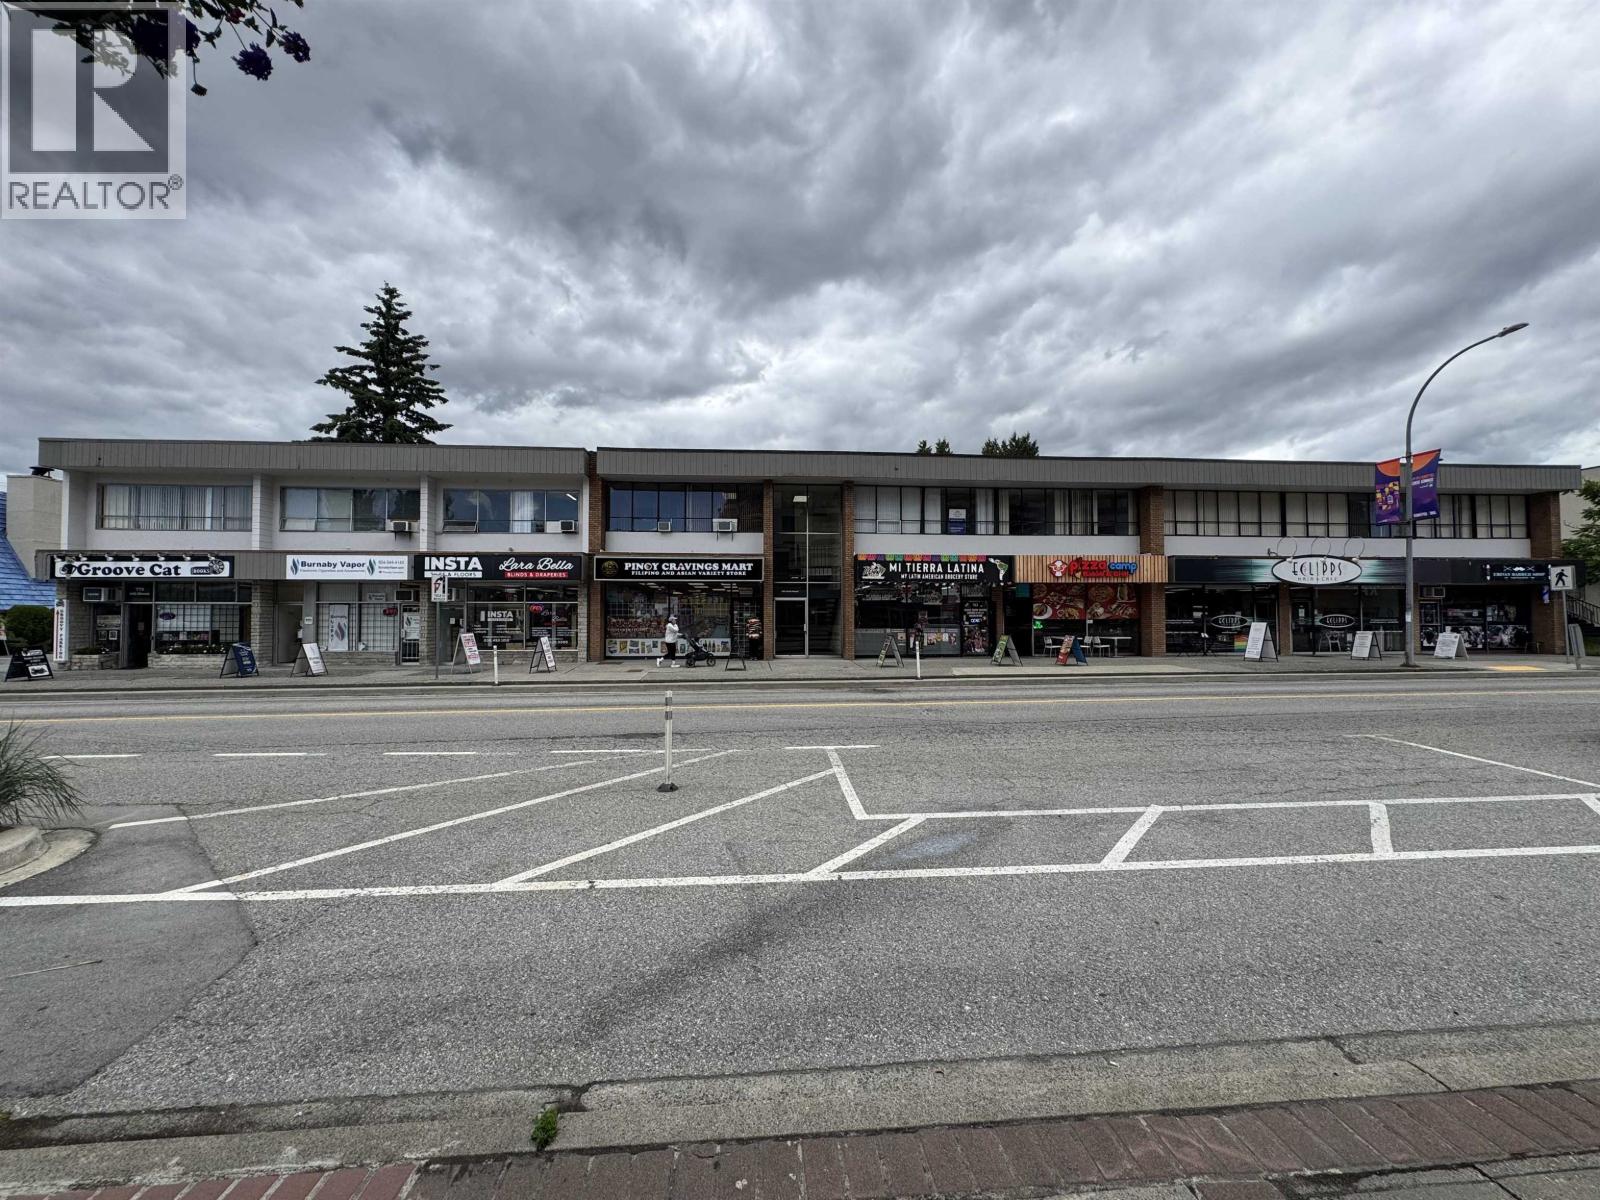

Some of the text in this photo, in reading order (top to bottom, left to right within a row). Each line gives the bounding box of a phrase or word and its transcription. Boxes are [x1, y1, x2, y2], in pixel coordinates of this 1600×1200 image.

[77, 563, 181, 576] Groove Cat
[301, 560, 366, 569] Burnaby Vapor
[424, 556, 483, 571] INSTA
[499, 557, 574, 571] Lara Bella
[624, 562, 754, 571] PINOY CRAVINGS MART
[889, 563, 984, 573] MI TIERRA LATINA
[1109, 562, 1137, 574] camp
[1292, 561, 1342, 576] ECLIPPS
[487, 610, 514, 618] INSTA
